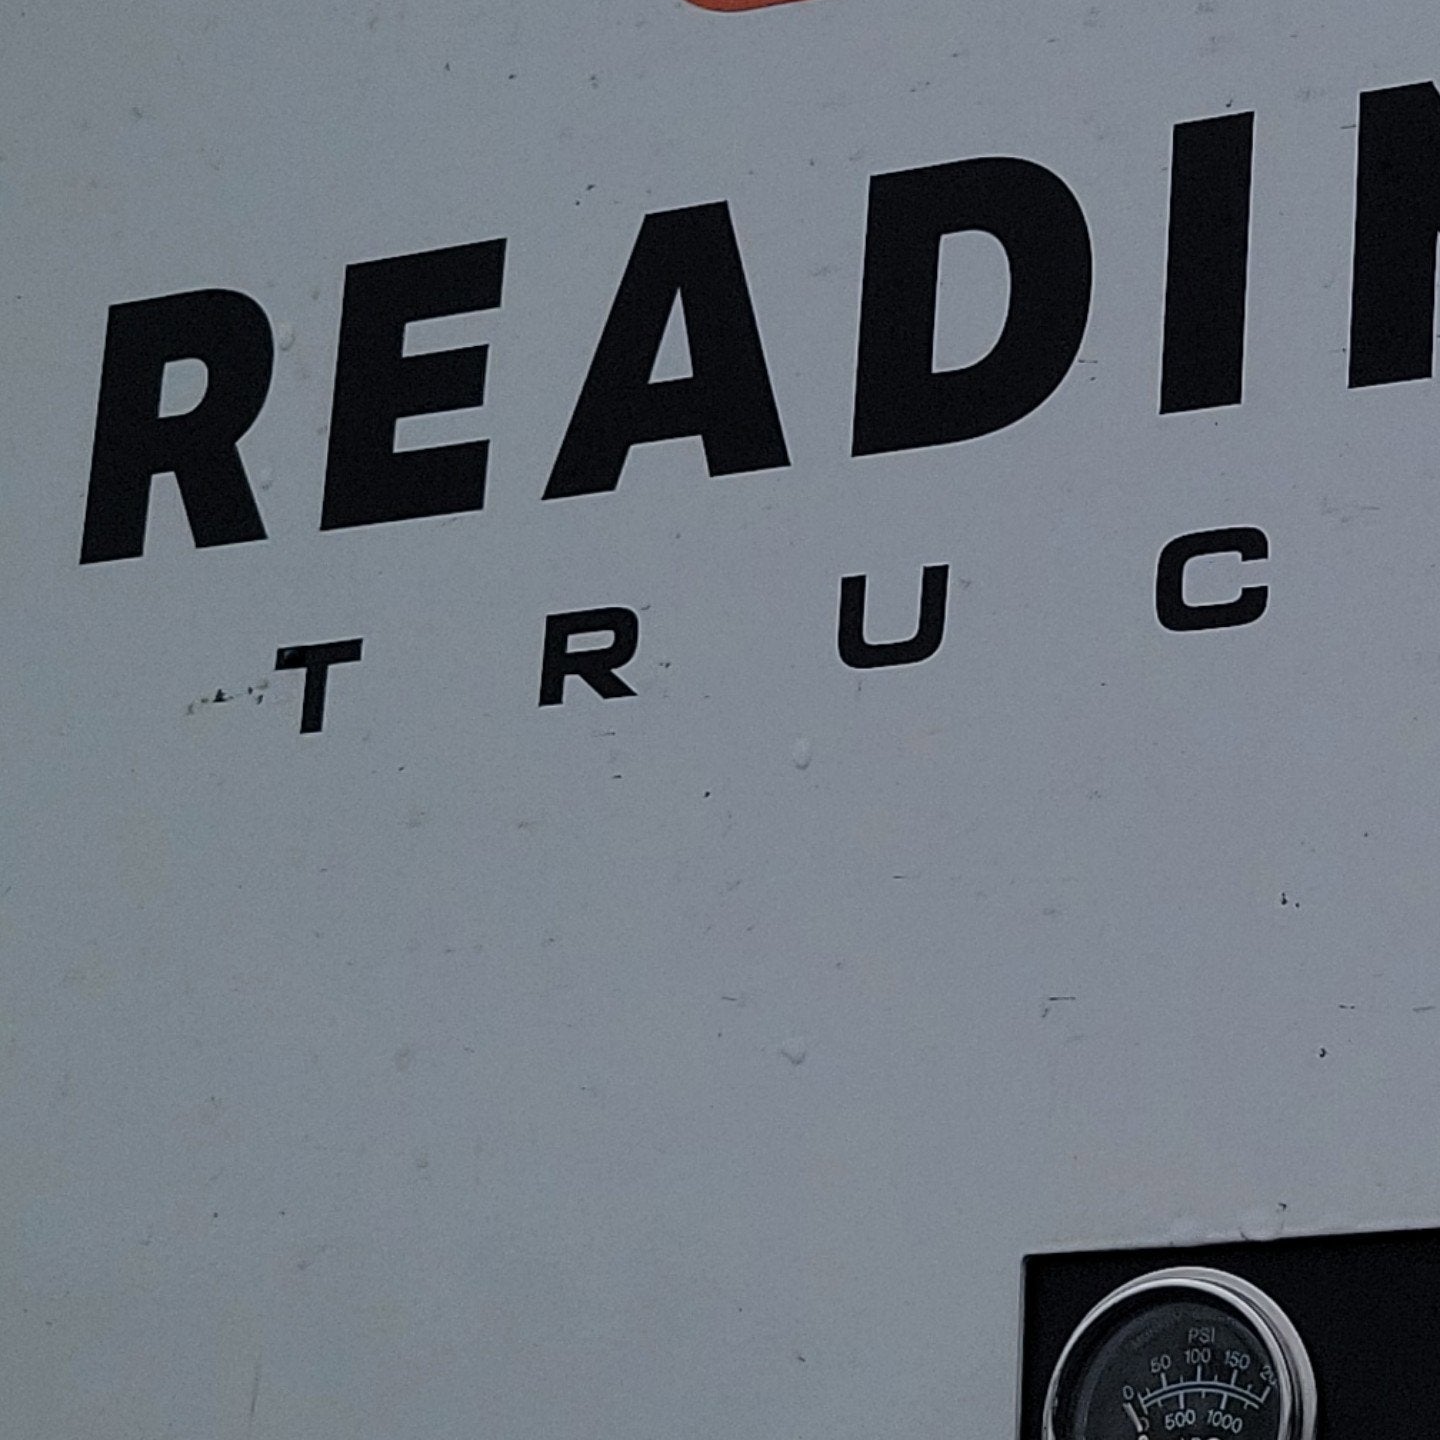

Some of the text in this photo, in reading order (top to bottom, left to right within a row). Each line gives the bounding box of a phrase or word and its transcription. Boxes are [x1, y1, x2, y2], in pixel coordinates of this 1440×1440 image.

[1188, 1328, 1215, 1344] PSI
[1122, 1385, 1134, 1400] 0
[1150, 1354, 1171, 1373] 50
[1184, 1348, 1211, 1364] 100
[1223, 1350, 1250, 1369] 150
[1164, 1409, 1196, 1431] 500
[1206, 1409, 1243, 1433] 1000
